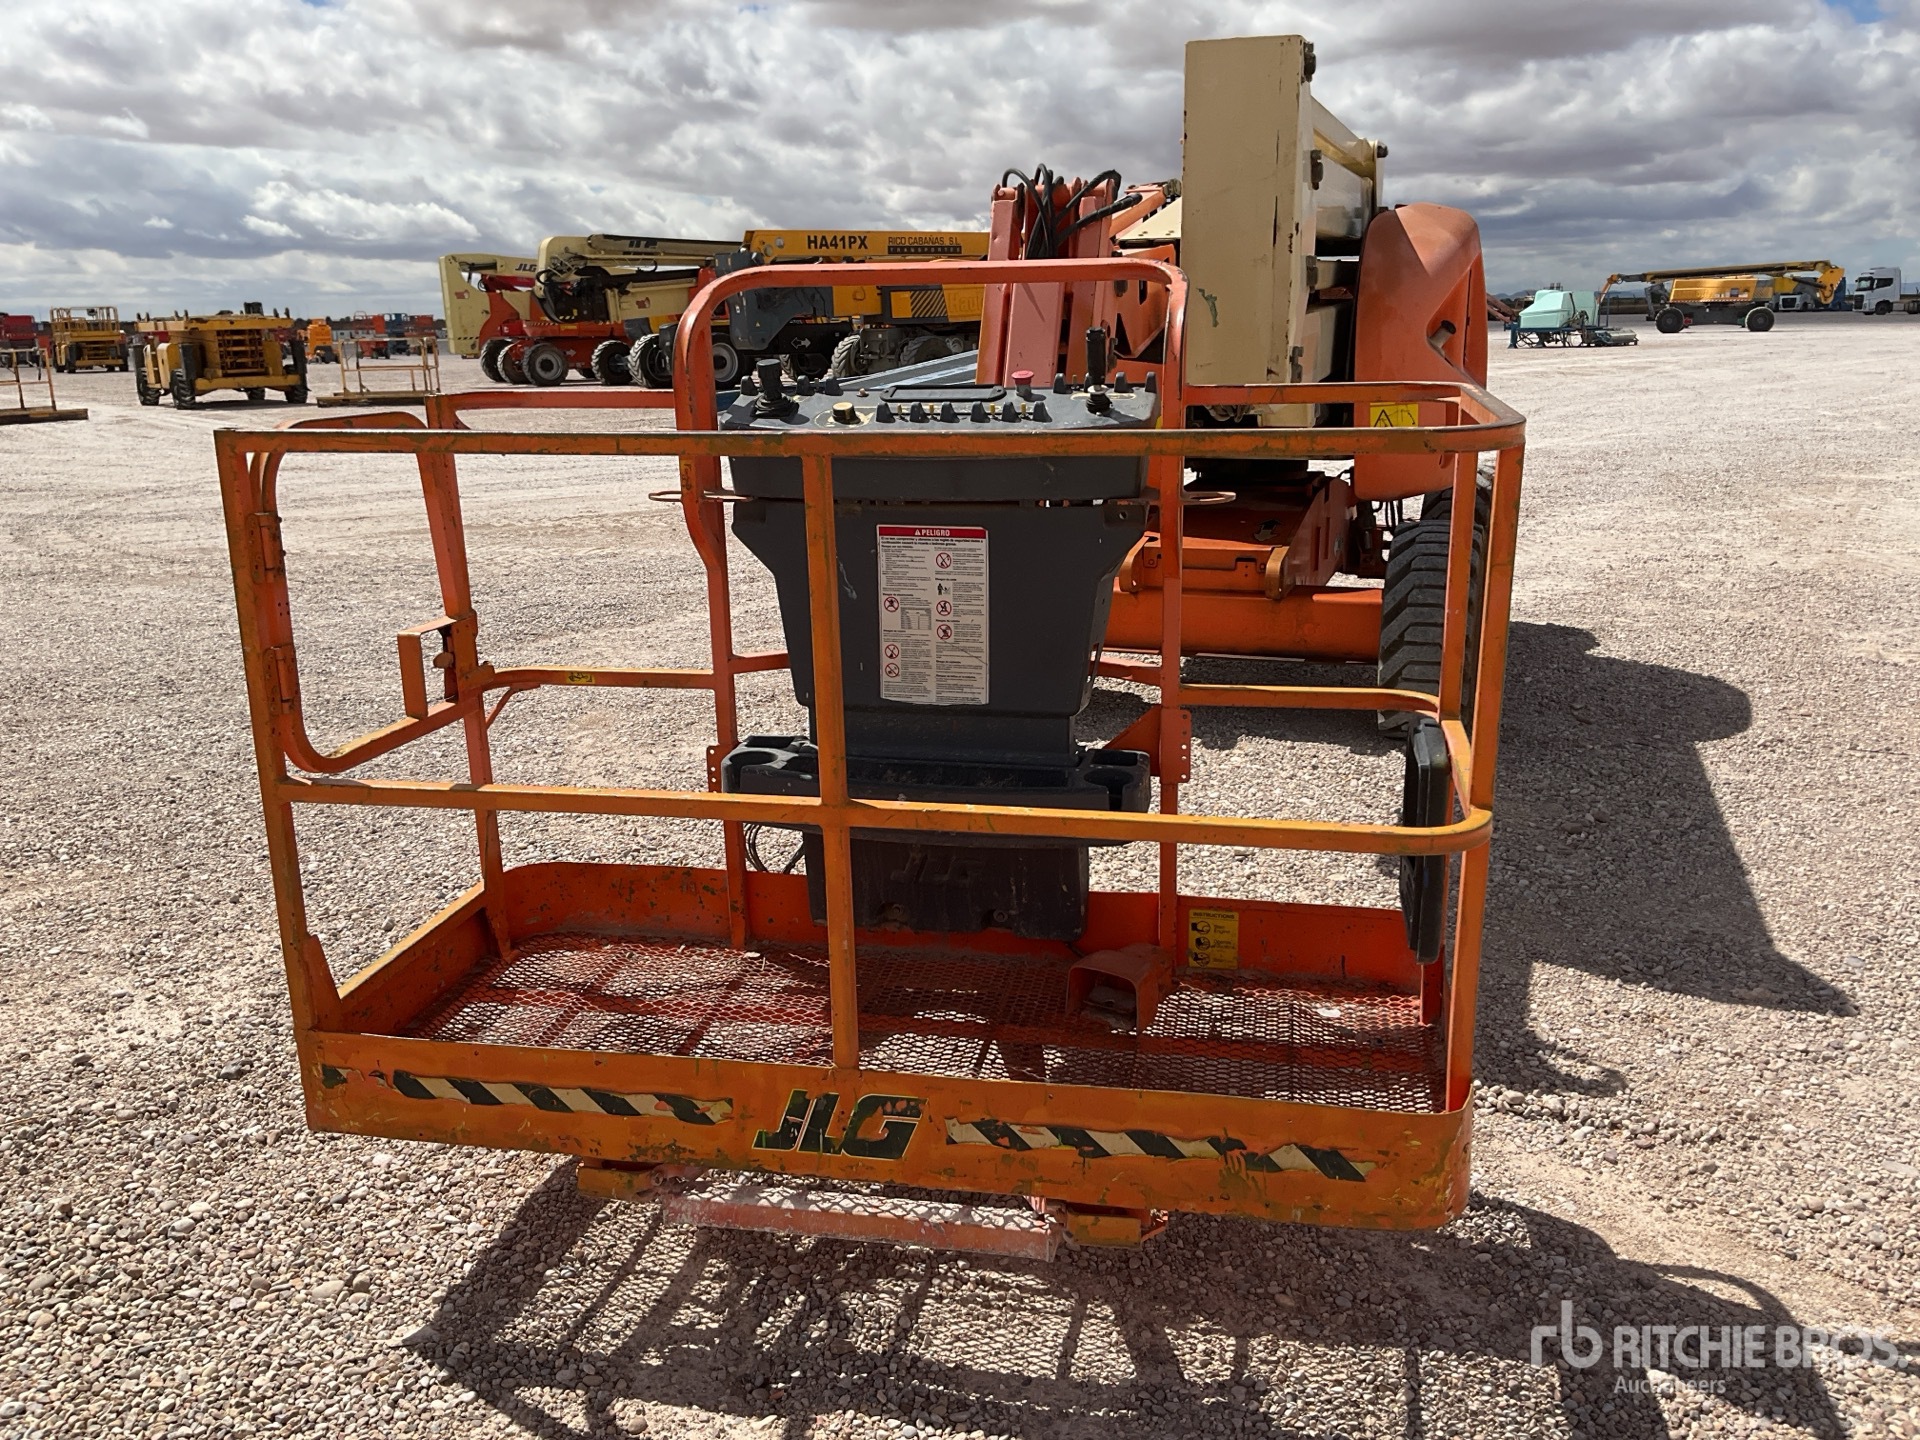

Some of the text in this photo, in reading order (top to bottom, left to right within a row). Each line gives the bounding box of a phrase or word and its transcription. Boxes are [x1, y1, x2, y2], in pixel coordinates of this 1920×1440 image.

[807, 235, 868, 250] HA41PX
[888, 236, 906, 245] RICO
[515, 263, 538, 273] JLG
[922, 529, 951, 537] PELIGRO
[1193, 911, 1235, 919] INSTRUCTIONS
[752, 1088, 929, 1160] JLG
